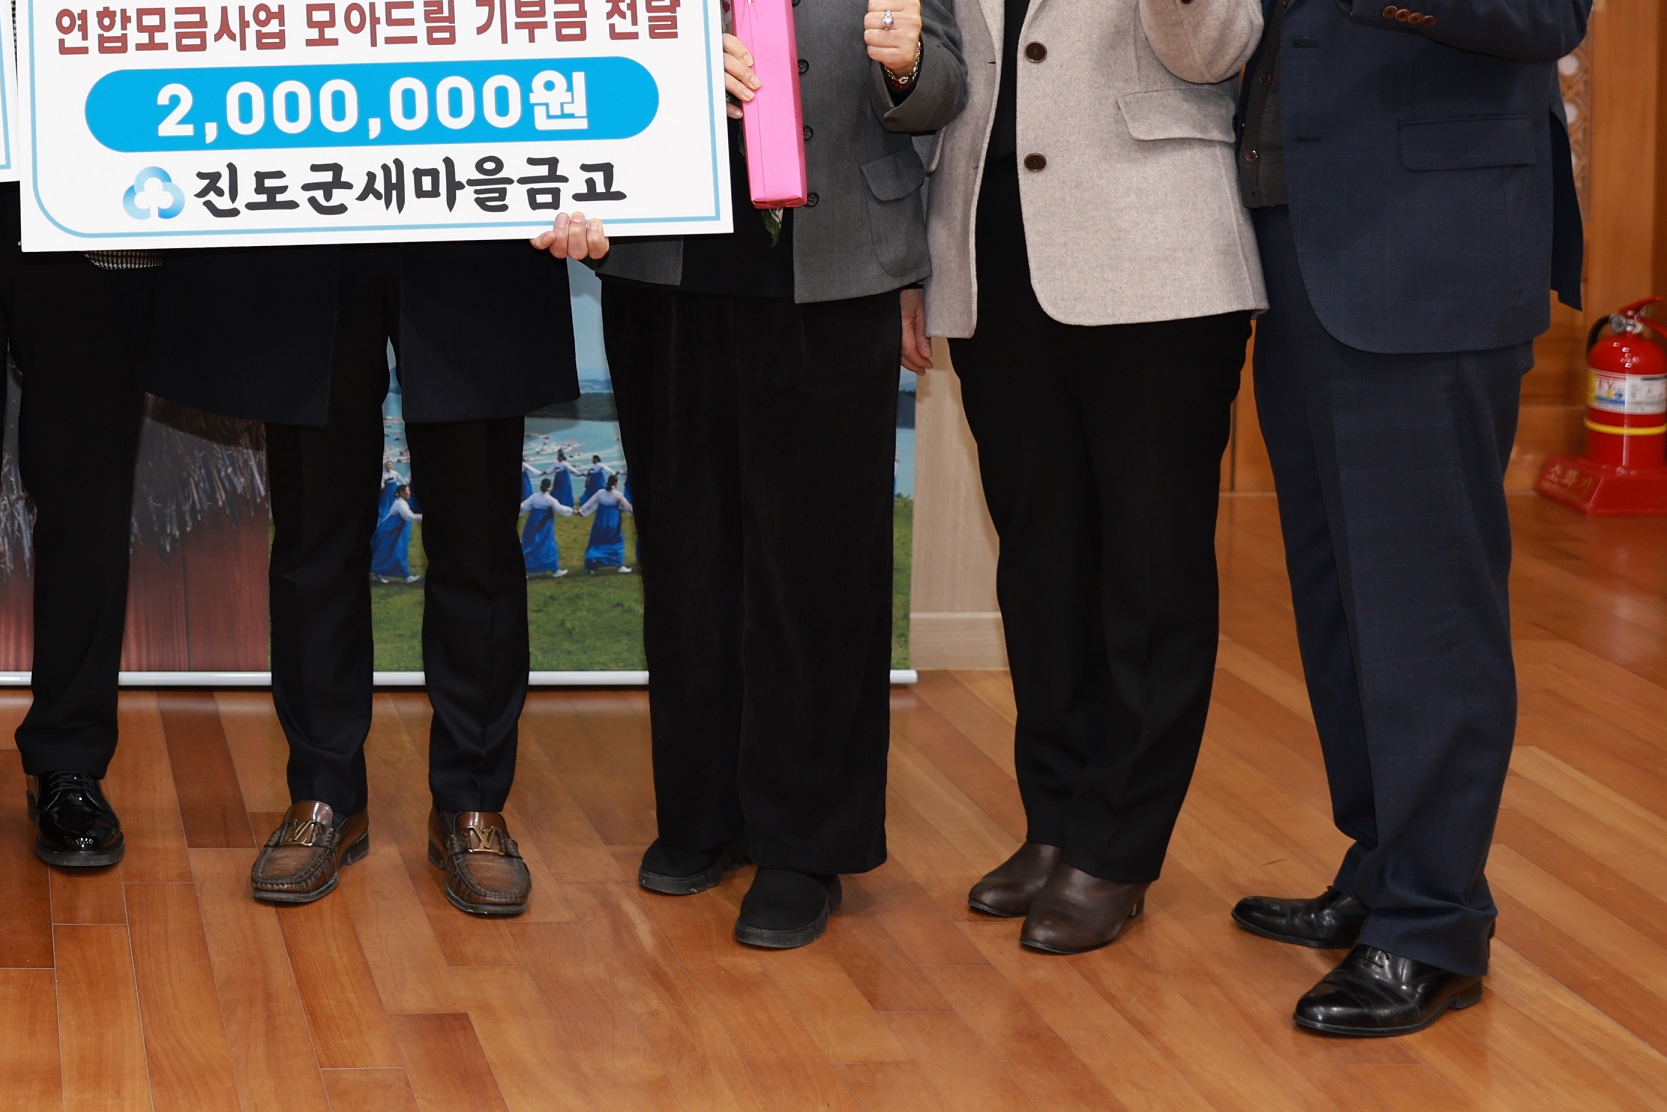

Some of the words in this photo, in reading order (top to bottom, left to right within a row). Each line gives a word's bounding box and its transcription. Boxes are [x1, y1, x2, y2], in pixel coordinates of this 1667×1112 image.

[55, 2, 286, 56] 연합모금사업
[305, 0, 457, 48] 모아드림
[156, 70, 589, 144] 2,000,000원
[193, 154, 628, 218] 진도군새마을금고
